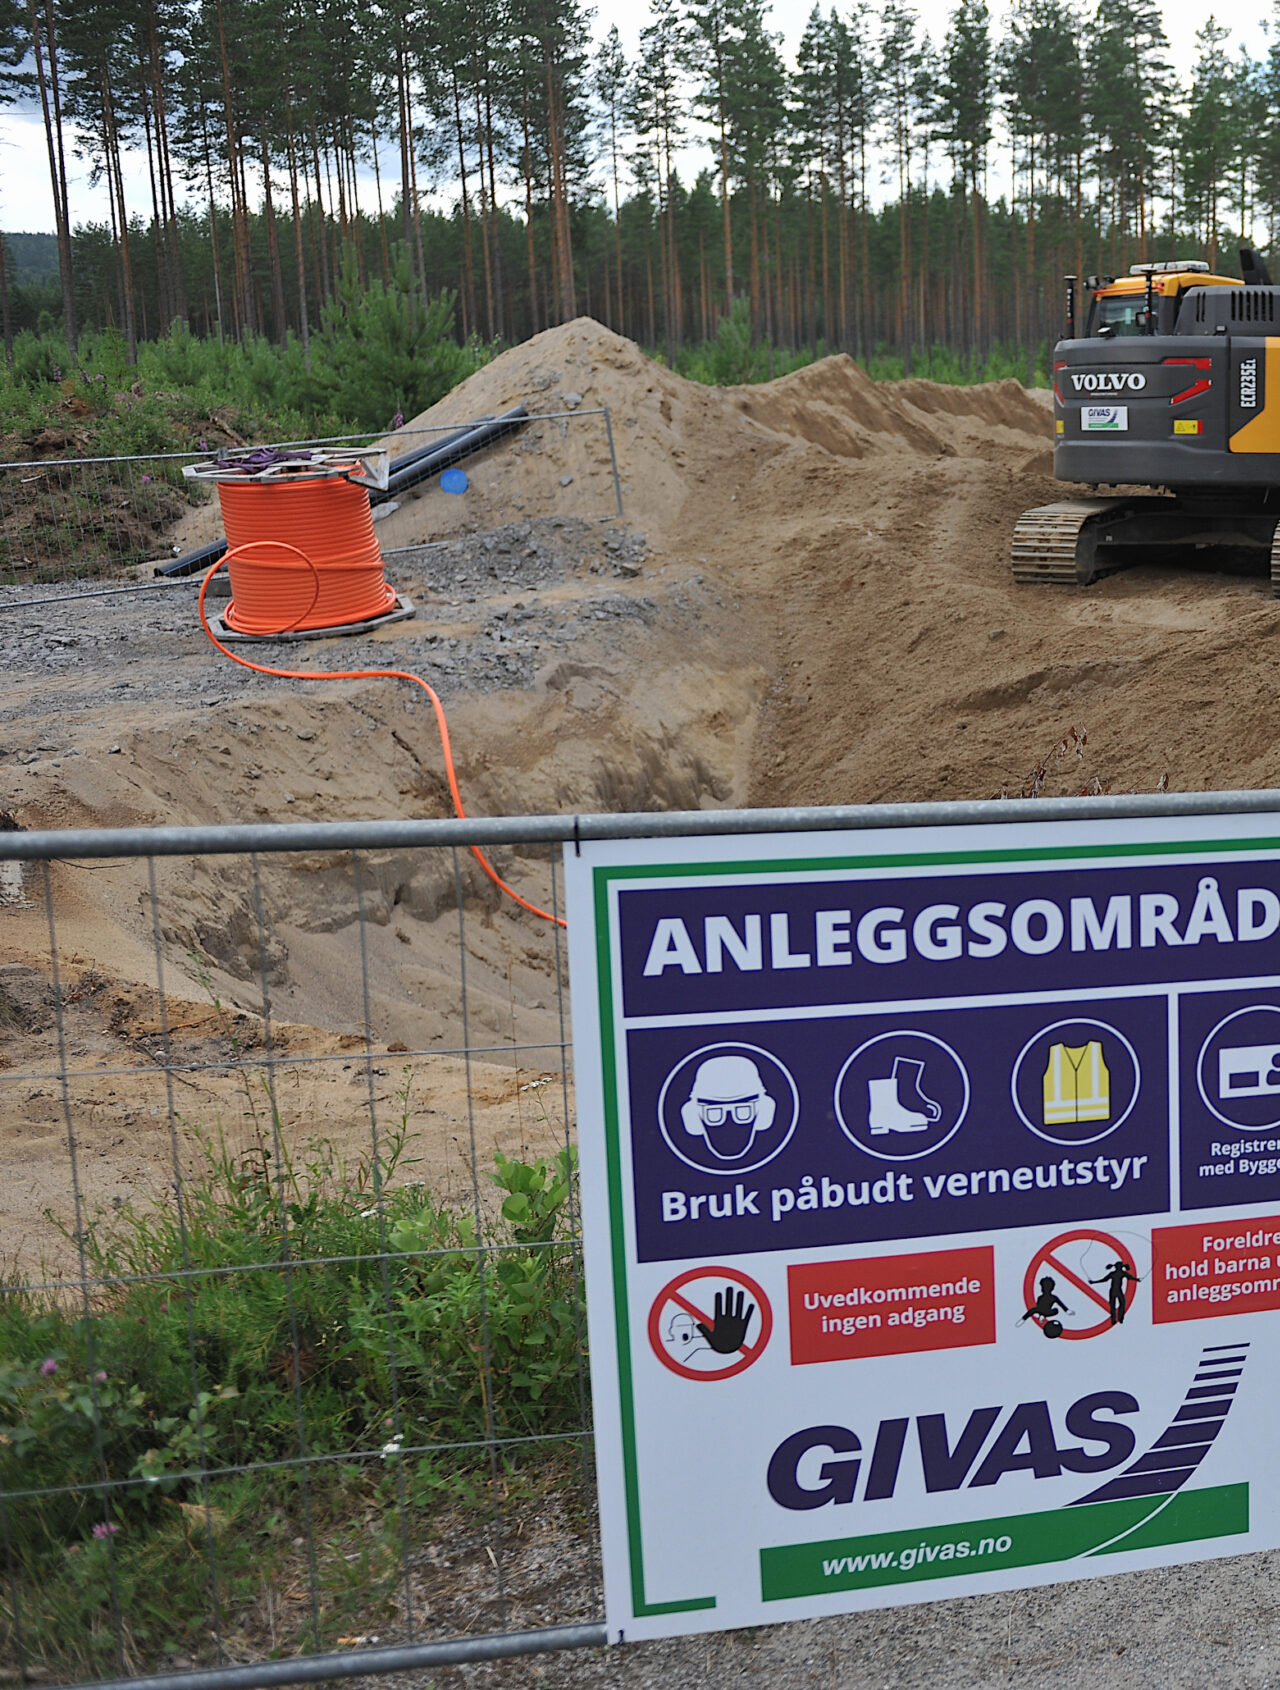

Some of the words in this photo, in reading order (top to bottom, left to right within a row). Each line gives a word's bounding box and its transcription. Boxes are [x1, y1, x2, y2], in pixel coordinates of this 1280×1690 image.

[1071, 373, 1146, 391] VOLVO
[1088, 408, 1111, 417] GIVAS
[1199, 1160, 1234, 1177] med
[661, 1183, 759, 1223] Bruk
[770, 1170, 915, 1223] påbudt
[924, 1154, 1148, 1196] verneutstyr
[1165, 1259, 1208, 1279] hold
[1215, 1255, 1271, 1276] barna
[803, 1277, 981, 1311] Uvedkommende
[821, 1309, 881, 1335] ingen
[887, 1301, 966, 1331] adgang
[766, 1390, 1140, 1511] GIVAS
[822, 1534, 1012, 1577] www.givas.no
